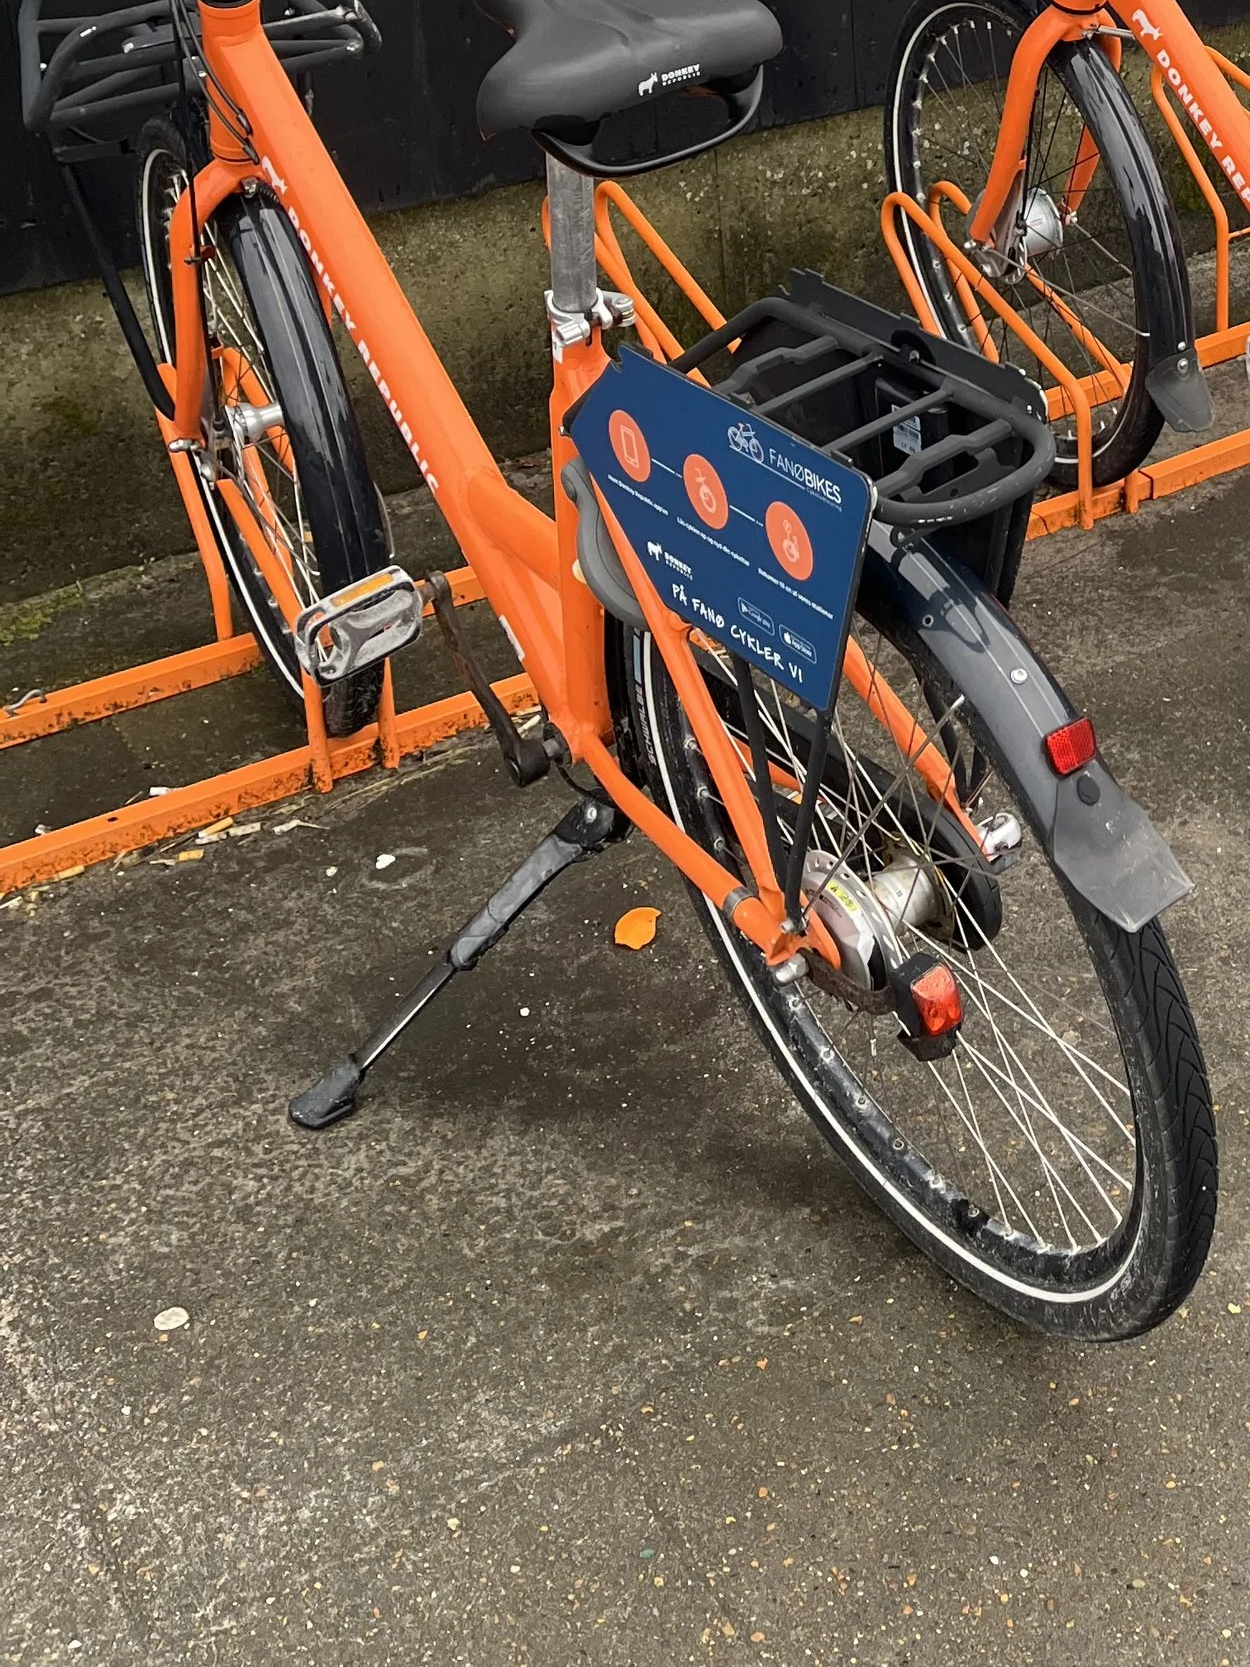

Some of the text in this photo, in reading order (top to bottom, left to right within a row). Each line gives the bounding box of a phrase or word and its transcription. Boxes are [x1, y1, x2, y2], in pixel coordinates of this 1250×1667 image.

[661, 63, 700, 81] DONKEY
[1156, 49, 1223, 149] DONKEY
[288, 206, 438, 494] DONKEY REPUBLIC
[769, 448, 842, 504] FANØBIKES
[664, 551, 691, 575] DONKEY
[672, 583, 803, 683] PÅ FANØ CYKLER VI
[635, 683, 657, 766] SCHWALBE
